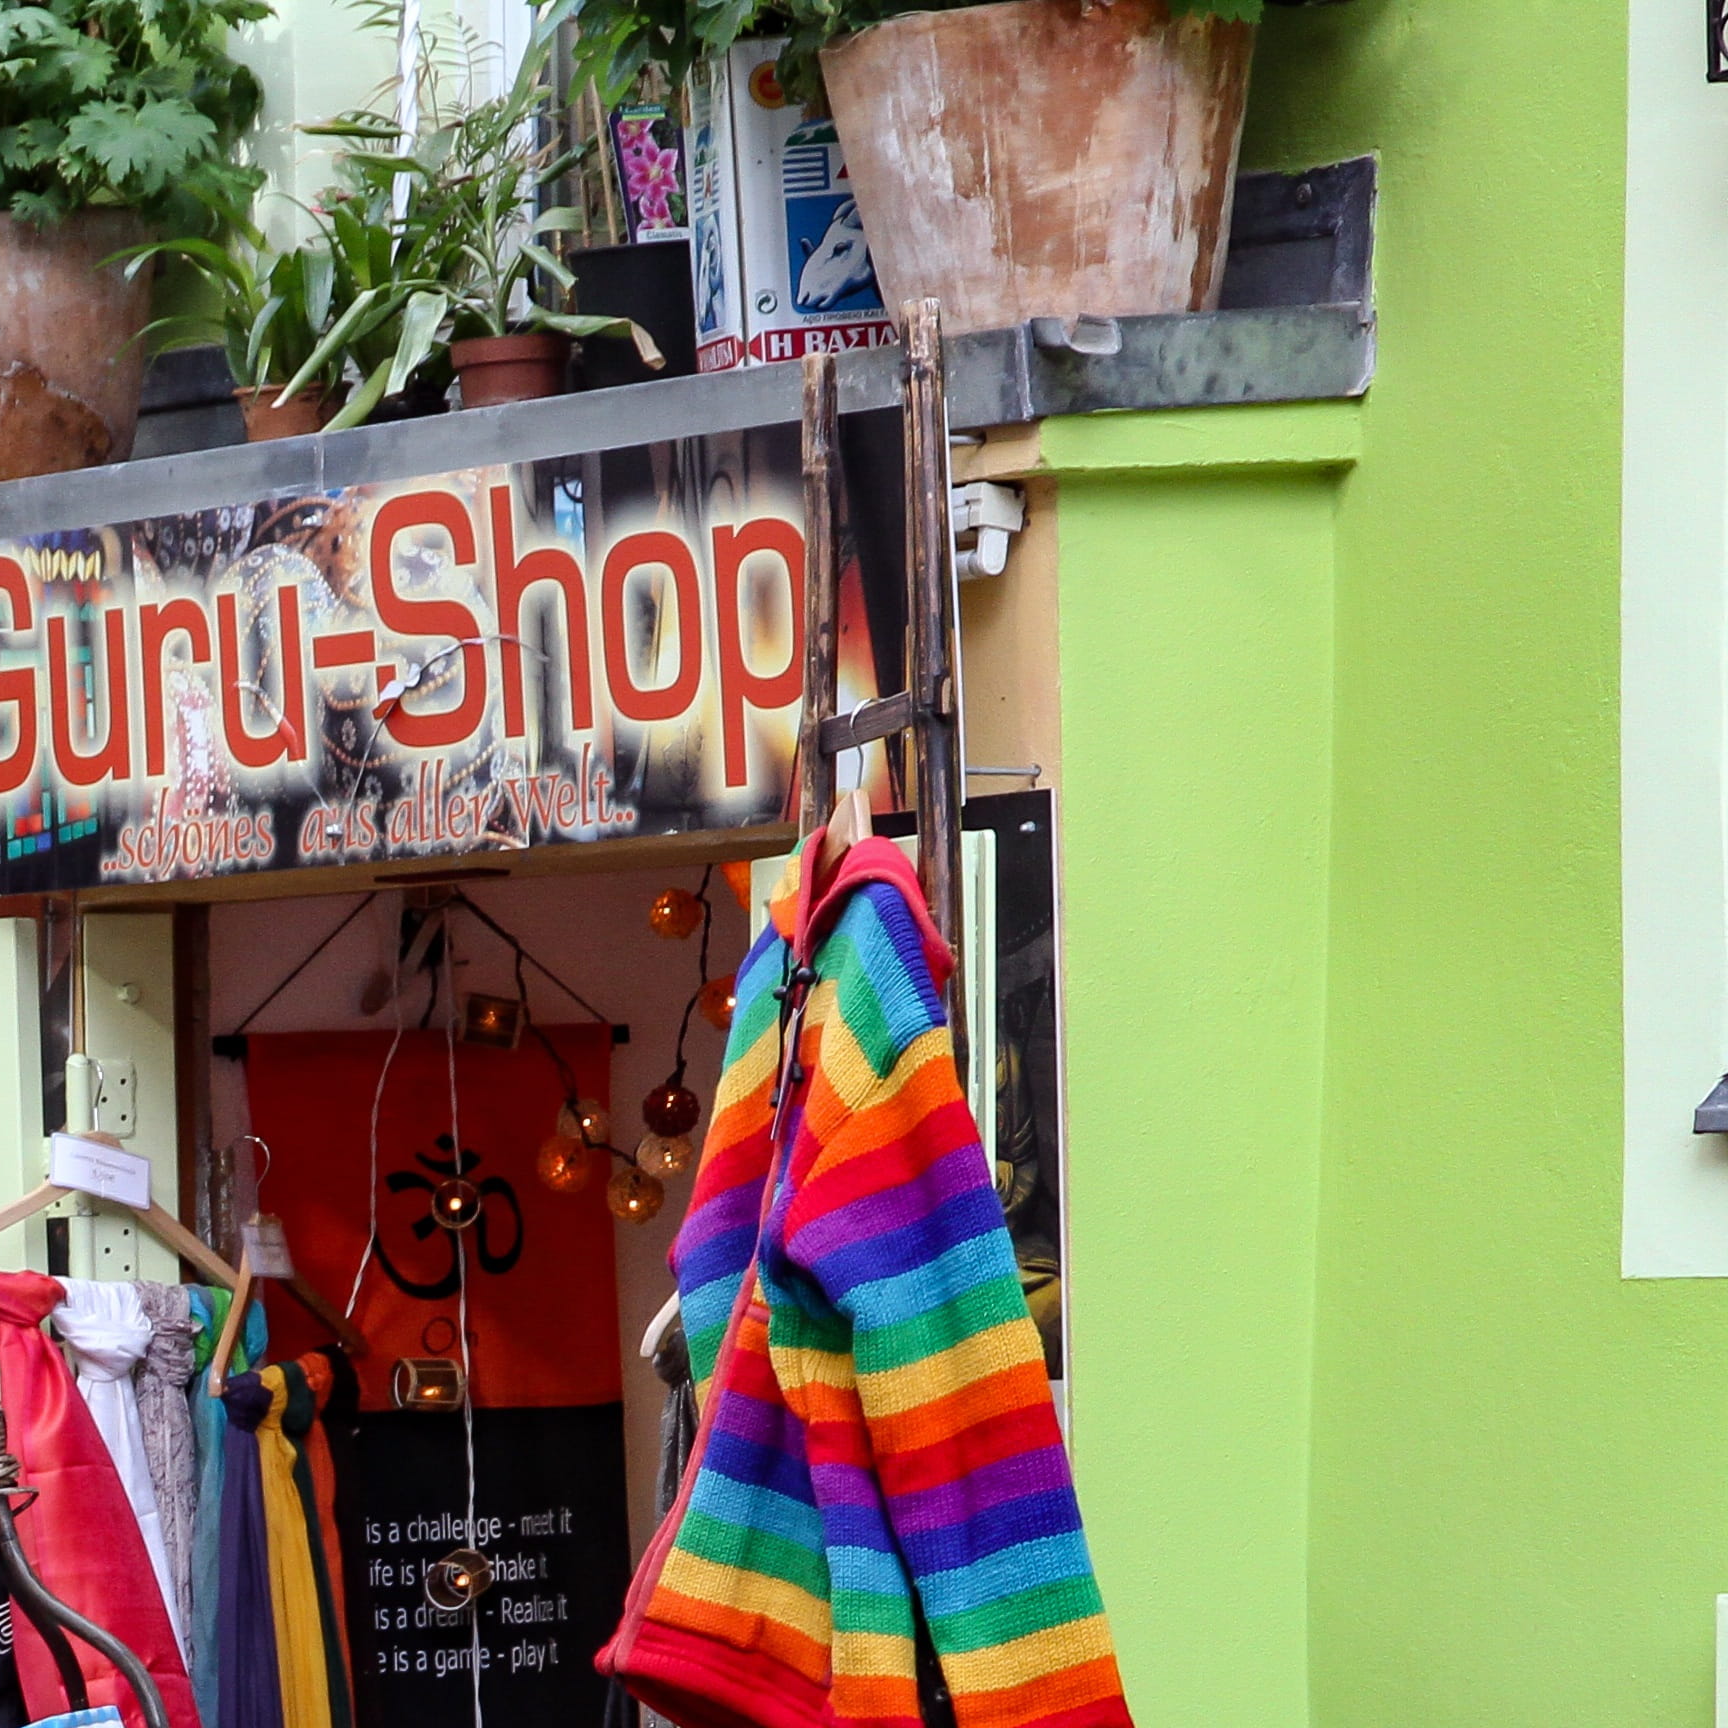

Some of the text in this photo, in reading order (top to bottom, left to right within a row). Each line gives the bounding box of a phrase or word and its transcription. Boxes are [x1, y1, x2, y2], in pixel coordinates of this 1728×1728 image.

[391, 758, 489, 844] aller
[365, 1516, 381, 1544] is
[388, 1521, 400, 1544] a
[407, 1512, 502, 1546] challenge
[521, 1508, 554, 1536] meet
[560, 1506, 572, 1534] it
[400, 1558, 415, 1586] is
[374, 1602, 390, 1630] is
[396, 1606, 408, 1629] a
[501, 1596, 554, 1625] Realize
[556, 1593, 568, 1621] it
[393, 1645, 409, 1672] is
[415, 1650, 427, 1672] a
[434, 1647, 490, 1678] game
[510, 1638, 546, 1674] play
